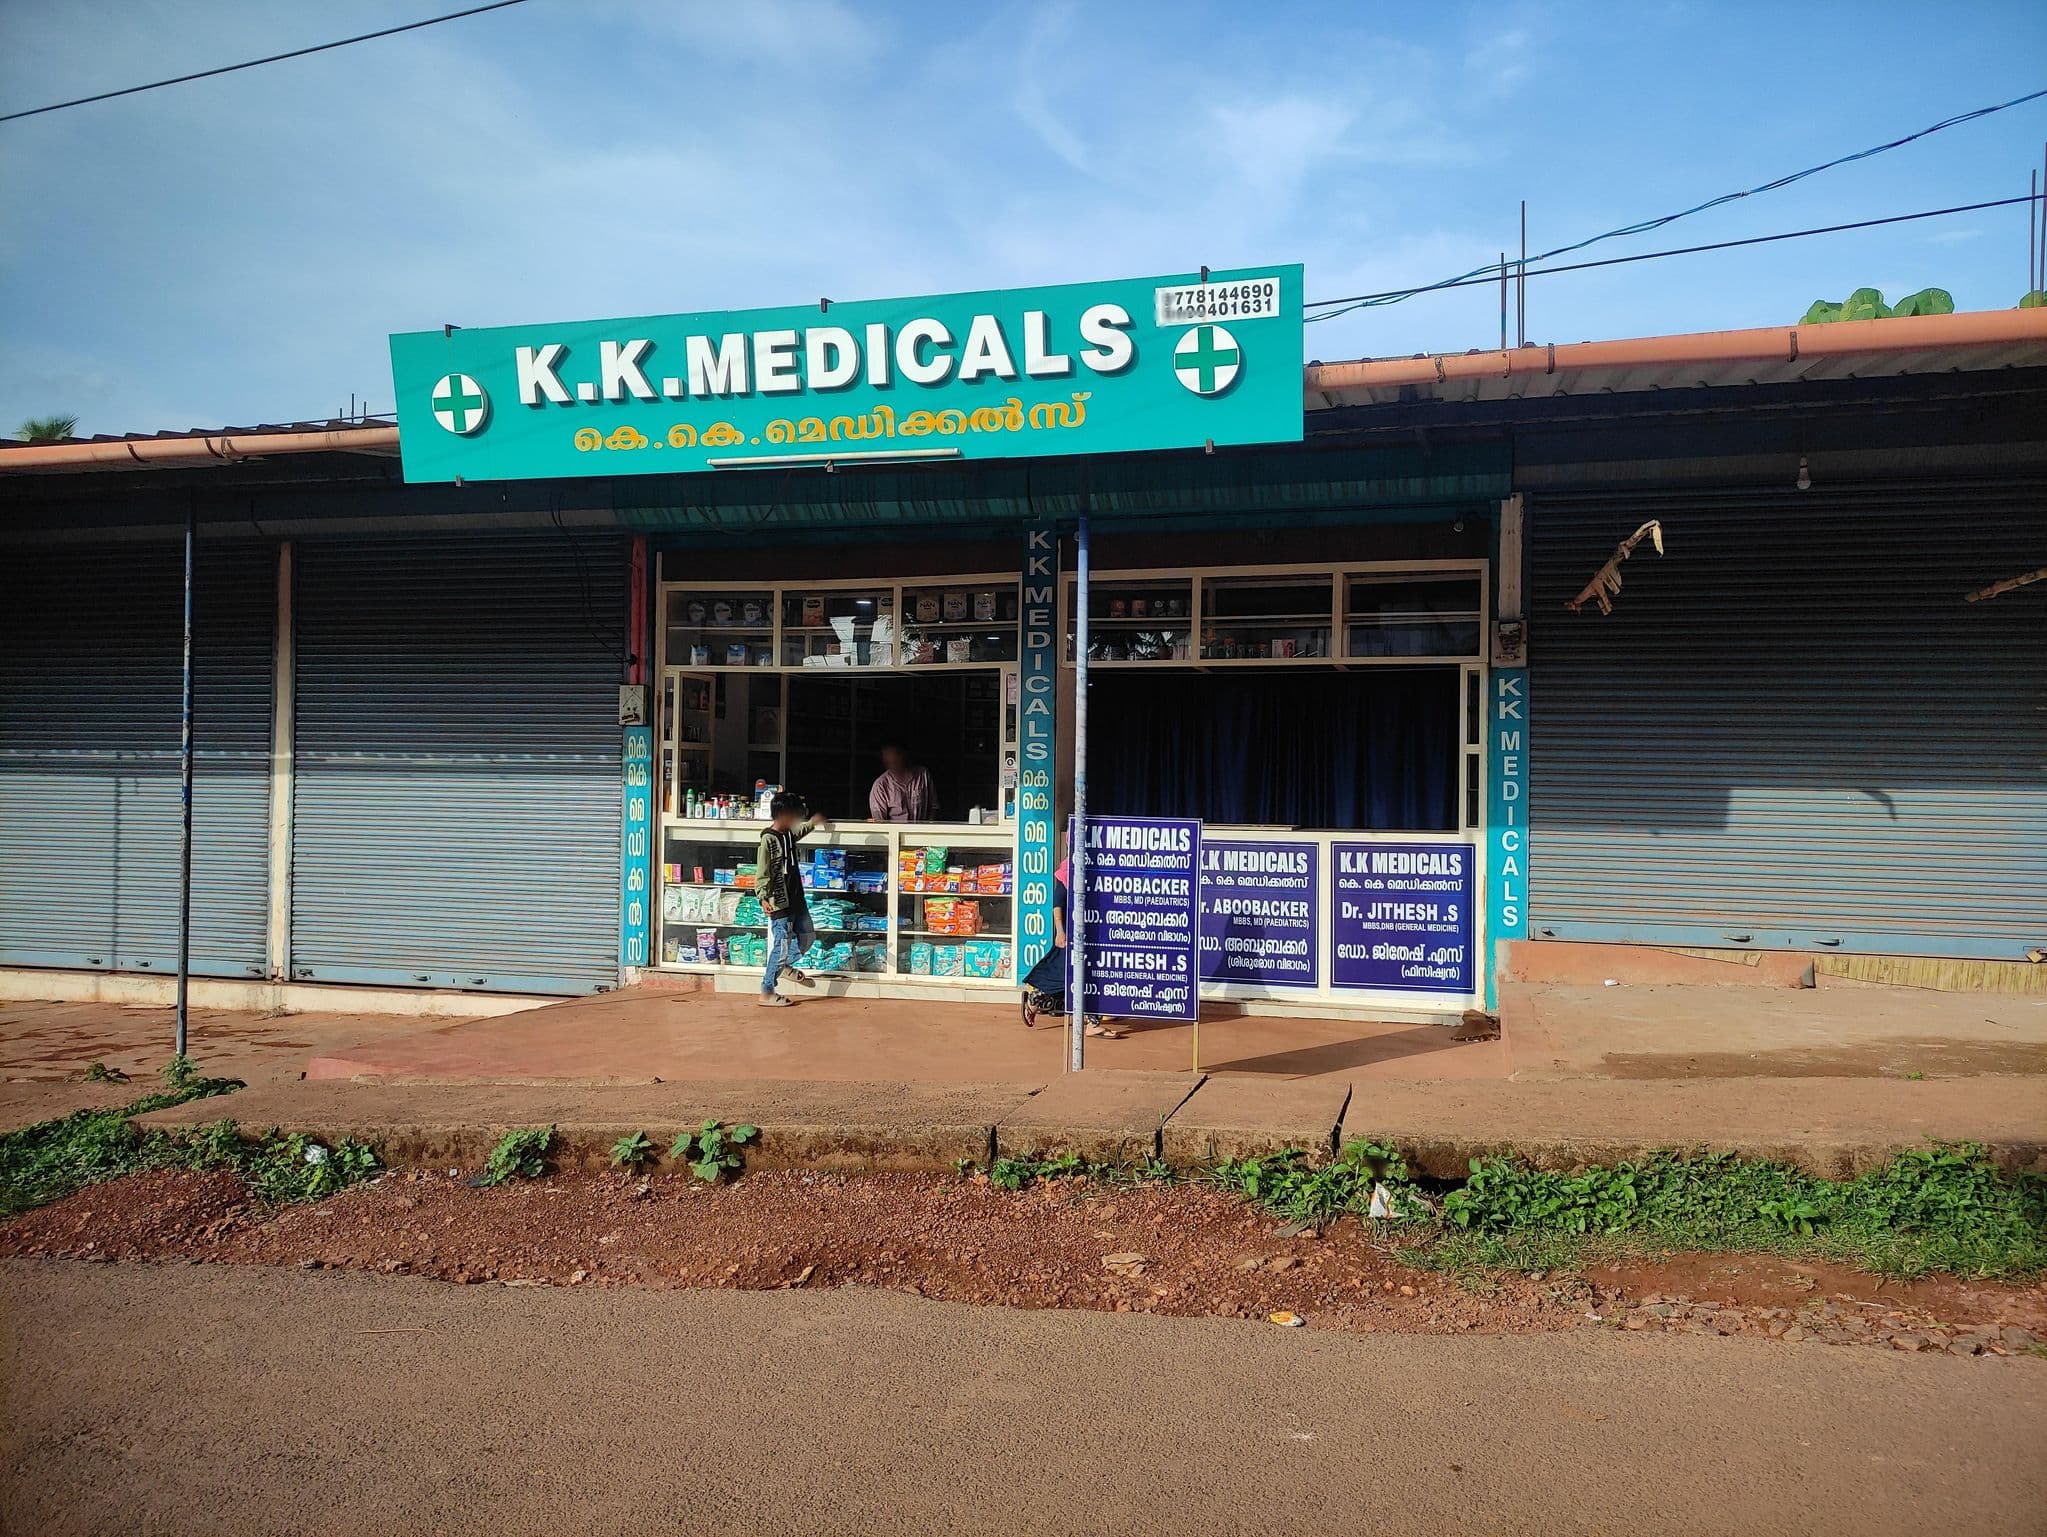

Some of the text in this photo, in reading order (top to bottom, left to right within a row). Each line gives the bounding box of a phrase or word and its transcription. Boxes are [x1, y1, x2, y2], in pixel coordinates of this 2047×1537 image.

[1163, 283, 1274, 305] 778144690
[1024, 586, 1053, 760] MEDICALS
[1500, 730, 1521, 927] MEDICALS
[1084, 826, 1191, 852] .K MEDICALS
[1223, 850, 1308, 873] MEDICALS
[1340, 852, 1462, 875] K.K MEDICALS
[1094, 876, 1190, 895] ABOOBACKER
[1134, 896, 1144, 905] MD
[1144, 897, 1190, 909] (PAEDIATRICS)
[1200, 899, 1309, 917] r. ABOOBACKER
[1341, 902, 1363, 919] Dr.
[1367, 903, 1438, 921] JITHESH
[1253, 917, 1263, 926] MD
[1264, 918, 1310, 930] (PAEDIATRICS)
[1395, 922, 1426, 932] (GENERAL
[1427, 924, 1460, 934] MEDICINE)
[1096, 951, 1167, 970] JITHESH
[1124, 971, 1155, 981] (GENERAL
[1156, 972, 1188, 983] MEDICINE)
